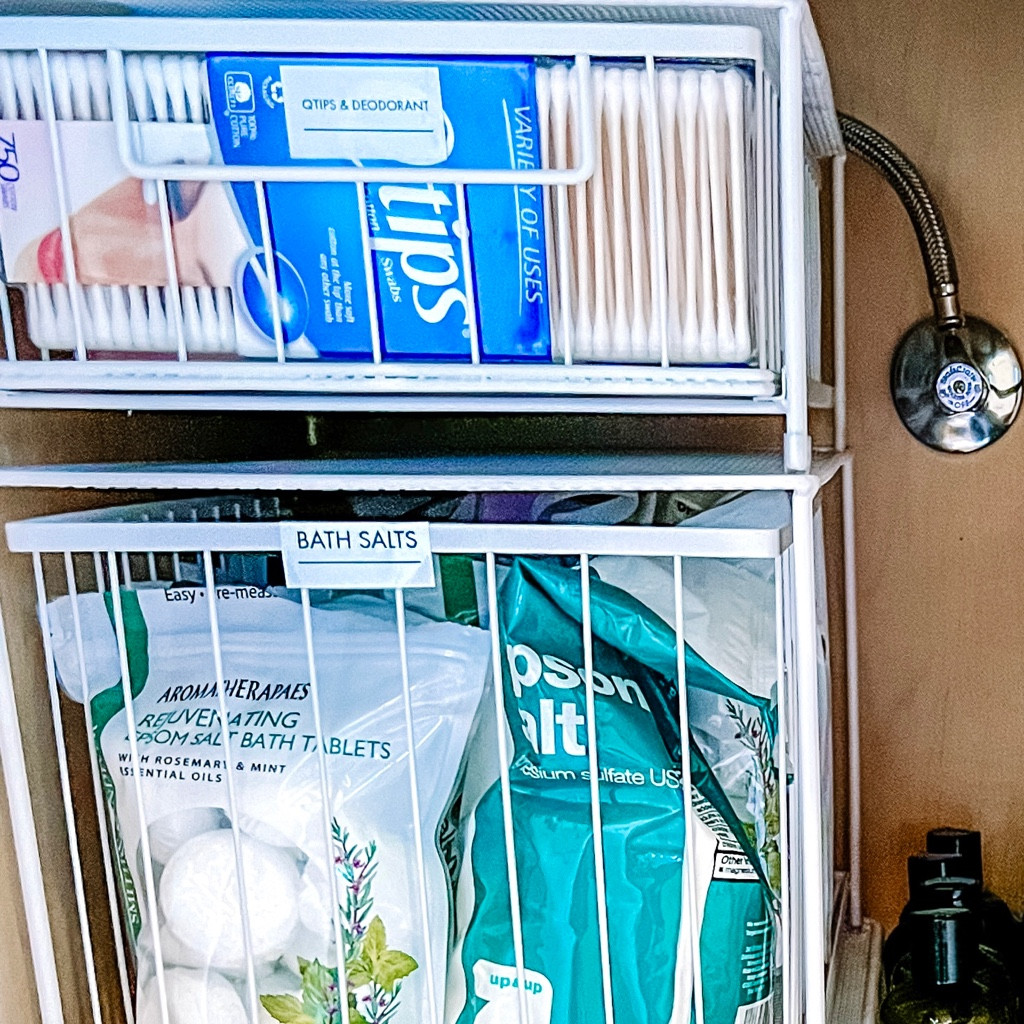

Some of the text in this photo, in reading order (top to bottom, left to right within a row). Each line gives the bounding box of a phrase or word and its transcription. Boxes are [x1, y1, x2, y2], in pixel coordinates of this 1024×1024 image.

[302, 97, 430, 113] QTIPS & DEODORANT
[514, 106, 544, 304] VARIEY OF USES
[369, 183, 470, 325] tips
[380, 257, 402, 303] Swabs
[297, 530, 418, 550] BATH SALTS
[165, 588, 196, 604] Easy
[157, 679, 312, 704] AROMAHERAPAES
[137, 708, 300, 730] REJUVENATING
[518, 698, 587, 757] alt
[240, 731, 295, 751] BATH
[302, 734, 391, 760] TABLETS
[118, 753, 150, 764] WIH
[235, 762, 244, 771] &
[250, 762, 287, 774] MINT
[191, 771, 223, 784] OILS
[581, 767, 688, 789] sulfate US
